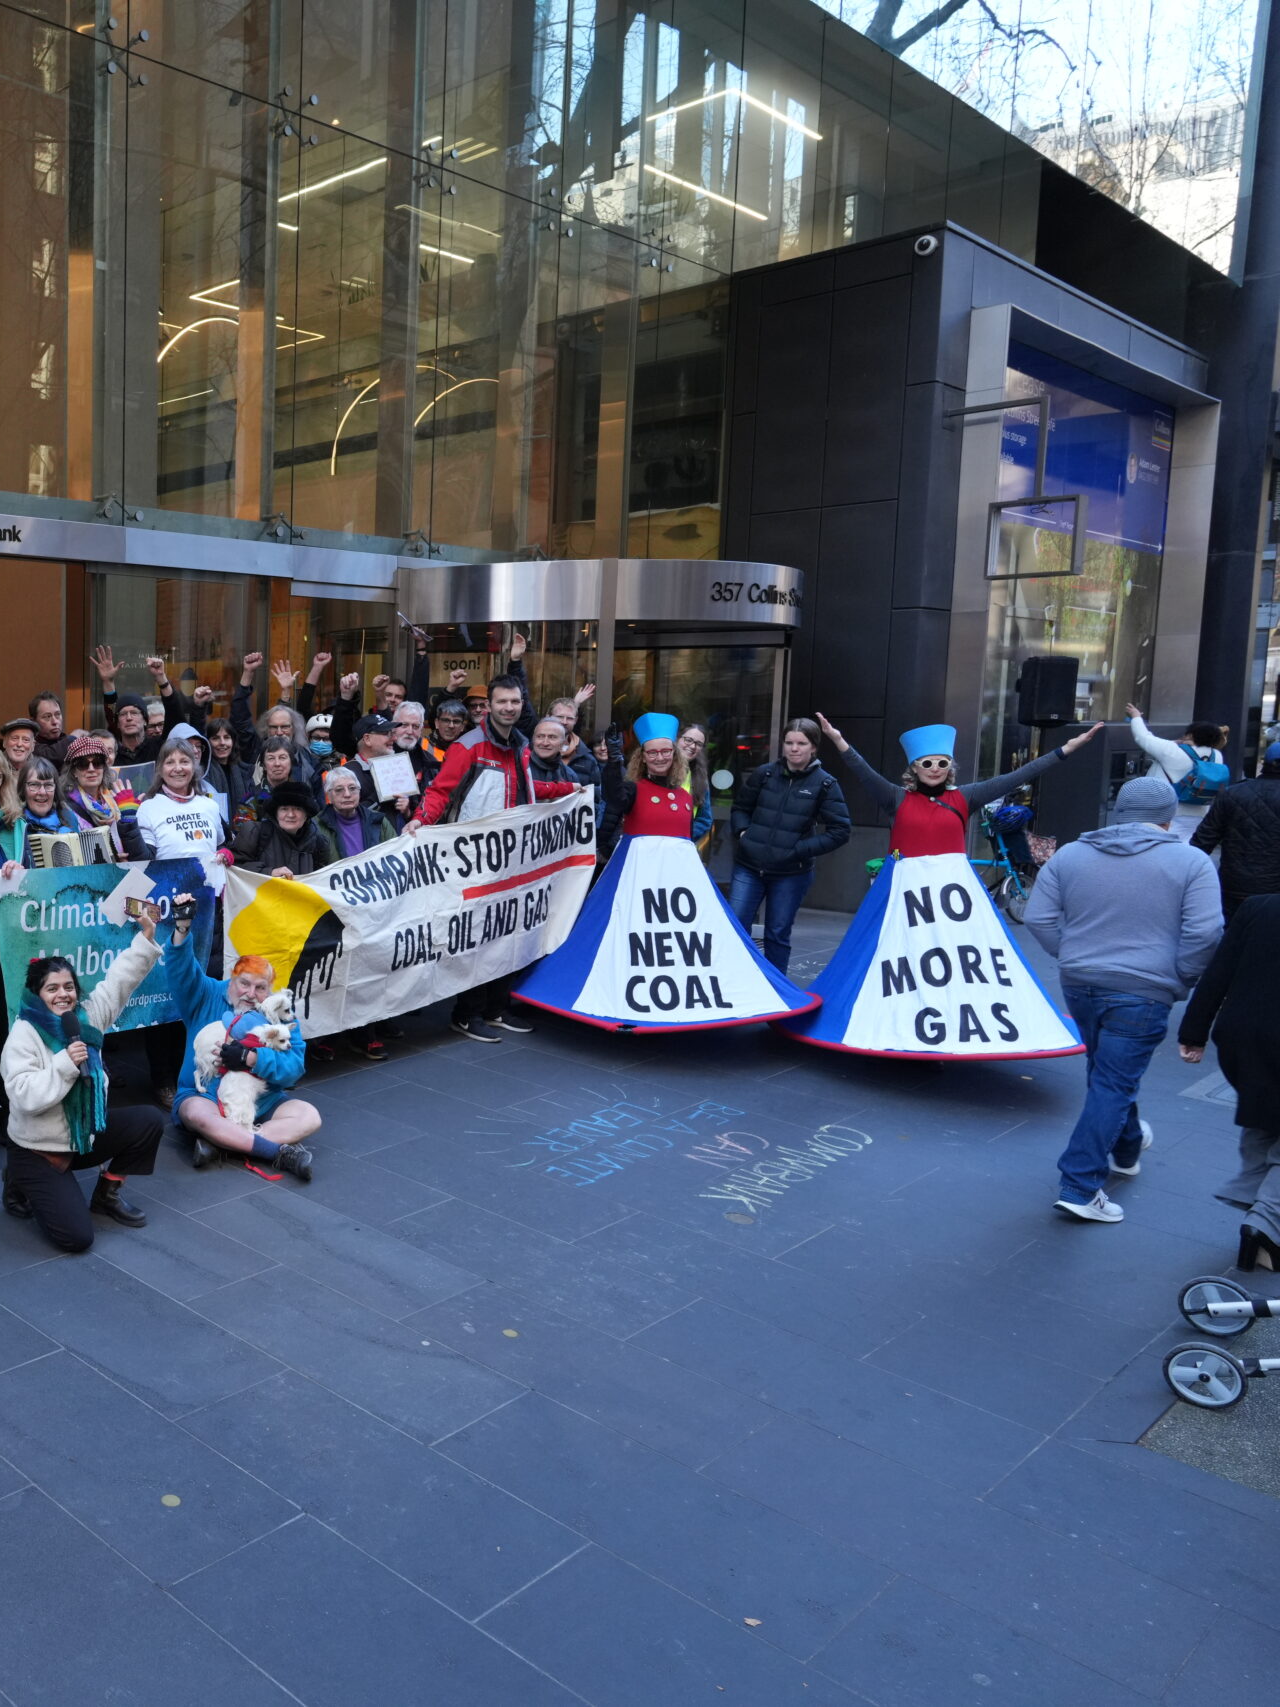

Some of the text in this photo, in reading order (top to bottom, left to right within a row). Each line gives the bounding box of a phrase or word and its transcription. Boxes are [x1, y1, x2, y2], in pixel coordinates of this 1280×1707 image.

[711, 581, 744, 602] 357
[747, 582, 787, 606] Collins
[442, 655, 481, 671] soon!
[166, 812, 202, 825] CLIMATE
[175, 820, 210, 831] ACTION
[184, 828, 213, 841] NOW
[330, 804, 594, 906] COMMBANK: STOP FUNDING
[641, 886, 697, 924] NO
[903, 882, 973, 928] NO
[391, 883, 552, 972] COAL, OIL AND GAS
[628, 931, 713, 967] NEW
[881, 944, 1013, 998] MORE
[625, 974, 734, 1013] COAL
[914, 1001, 1020, 1046] GAS
